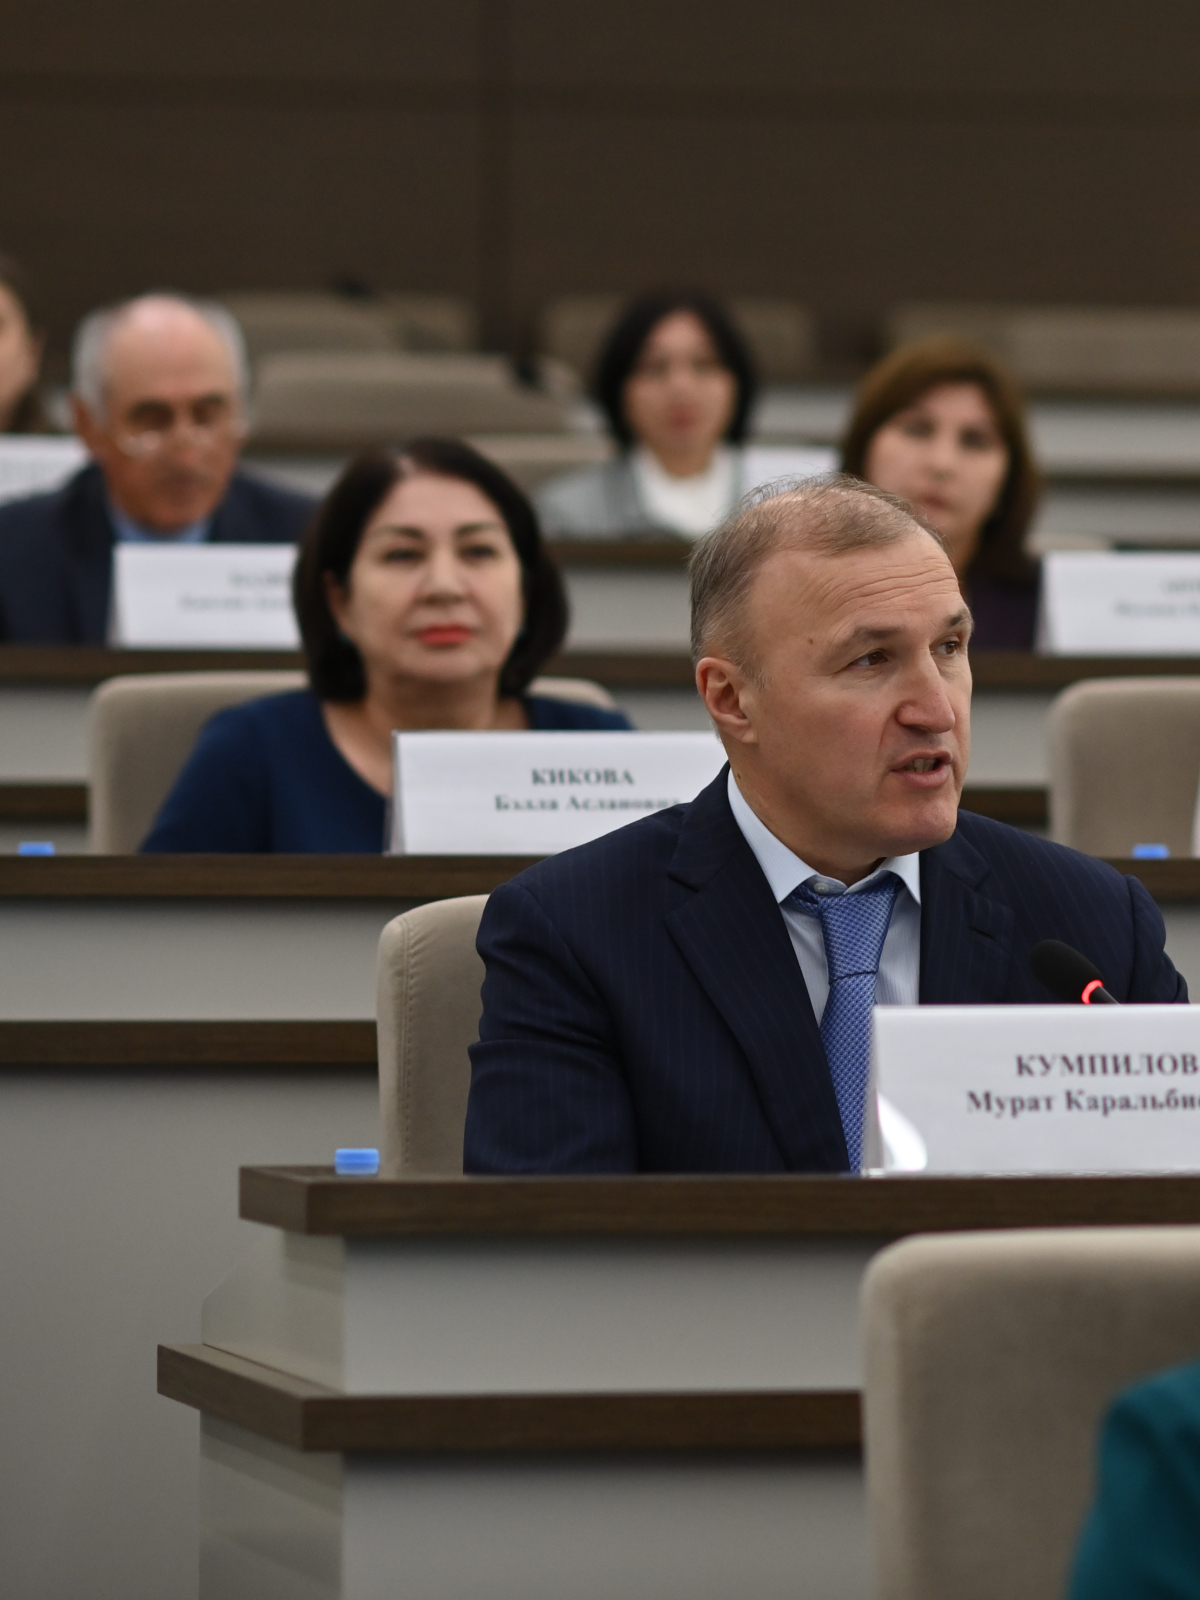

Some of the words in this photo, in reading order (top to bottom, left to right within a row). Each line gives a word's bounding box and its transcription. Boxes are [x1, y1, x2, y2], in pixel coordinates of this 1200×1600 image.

[531, 767, 635, 786] КИКОВА
[1015, 1053, 1200, 1077] КУМПИЛОВ
[967, 1090, 1055, 1118] Мурат
